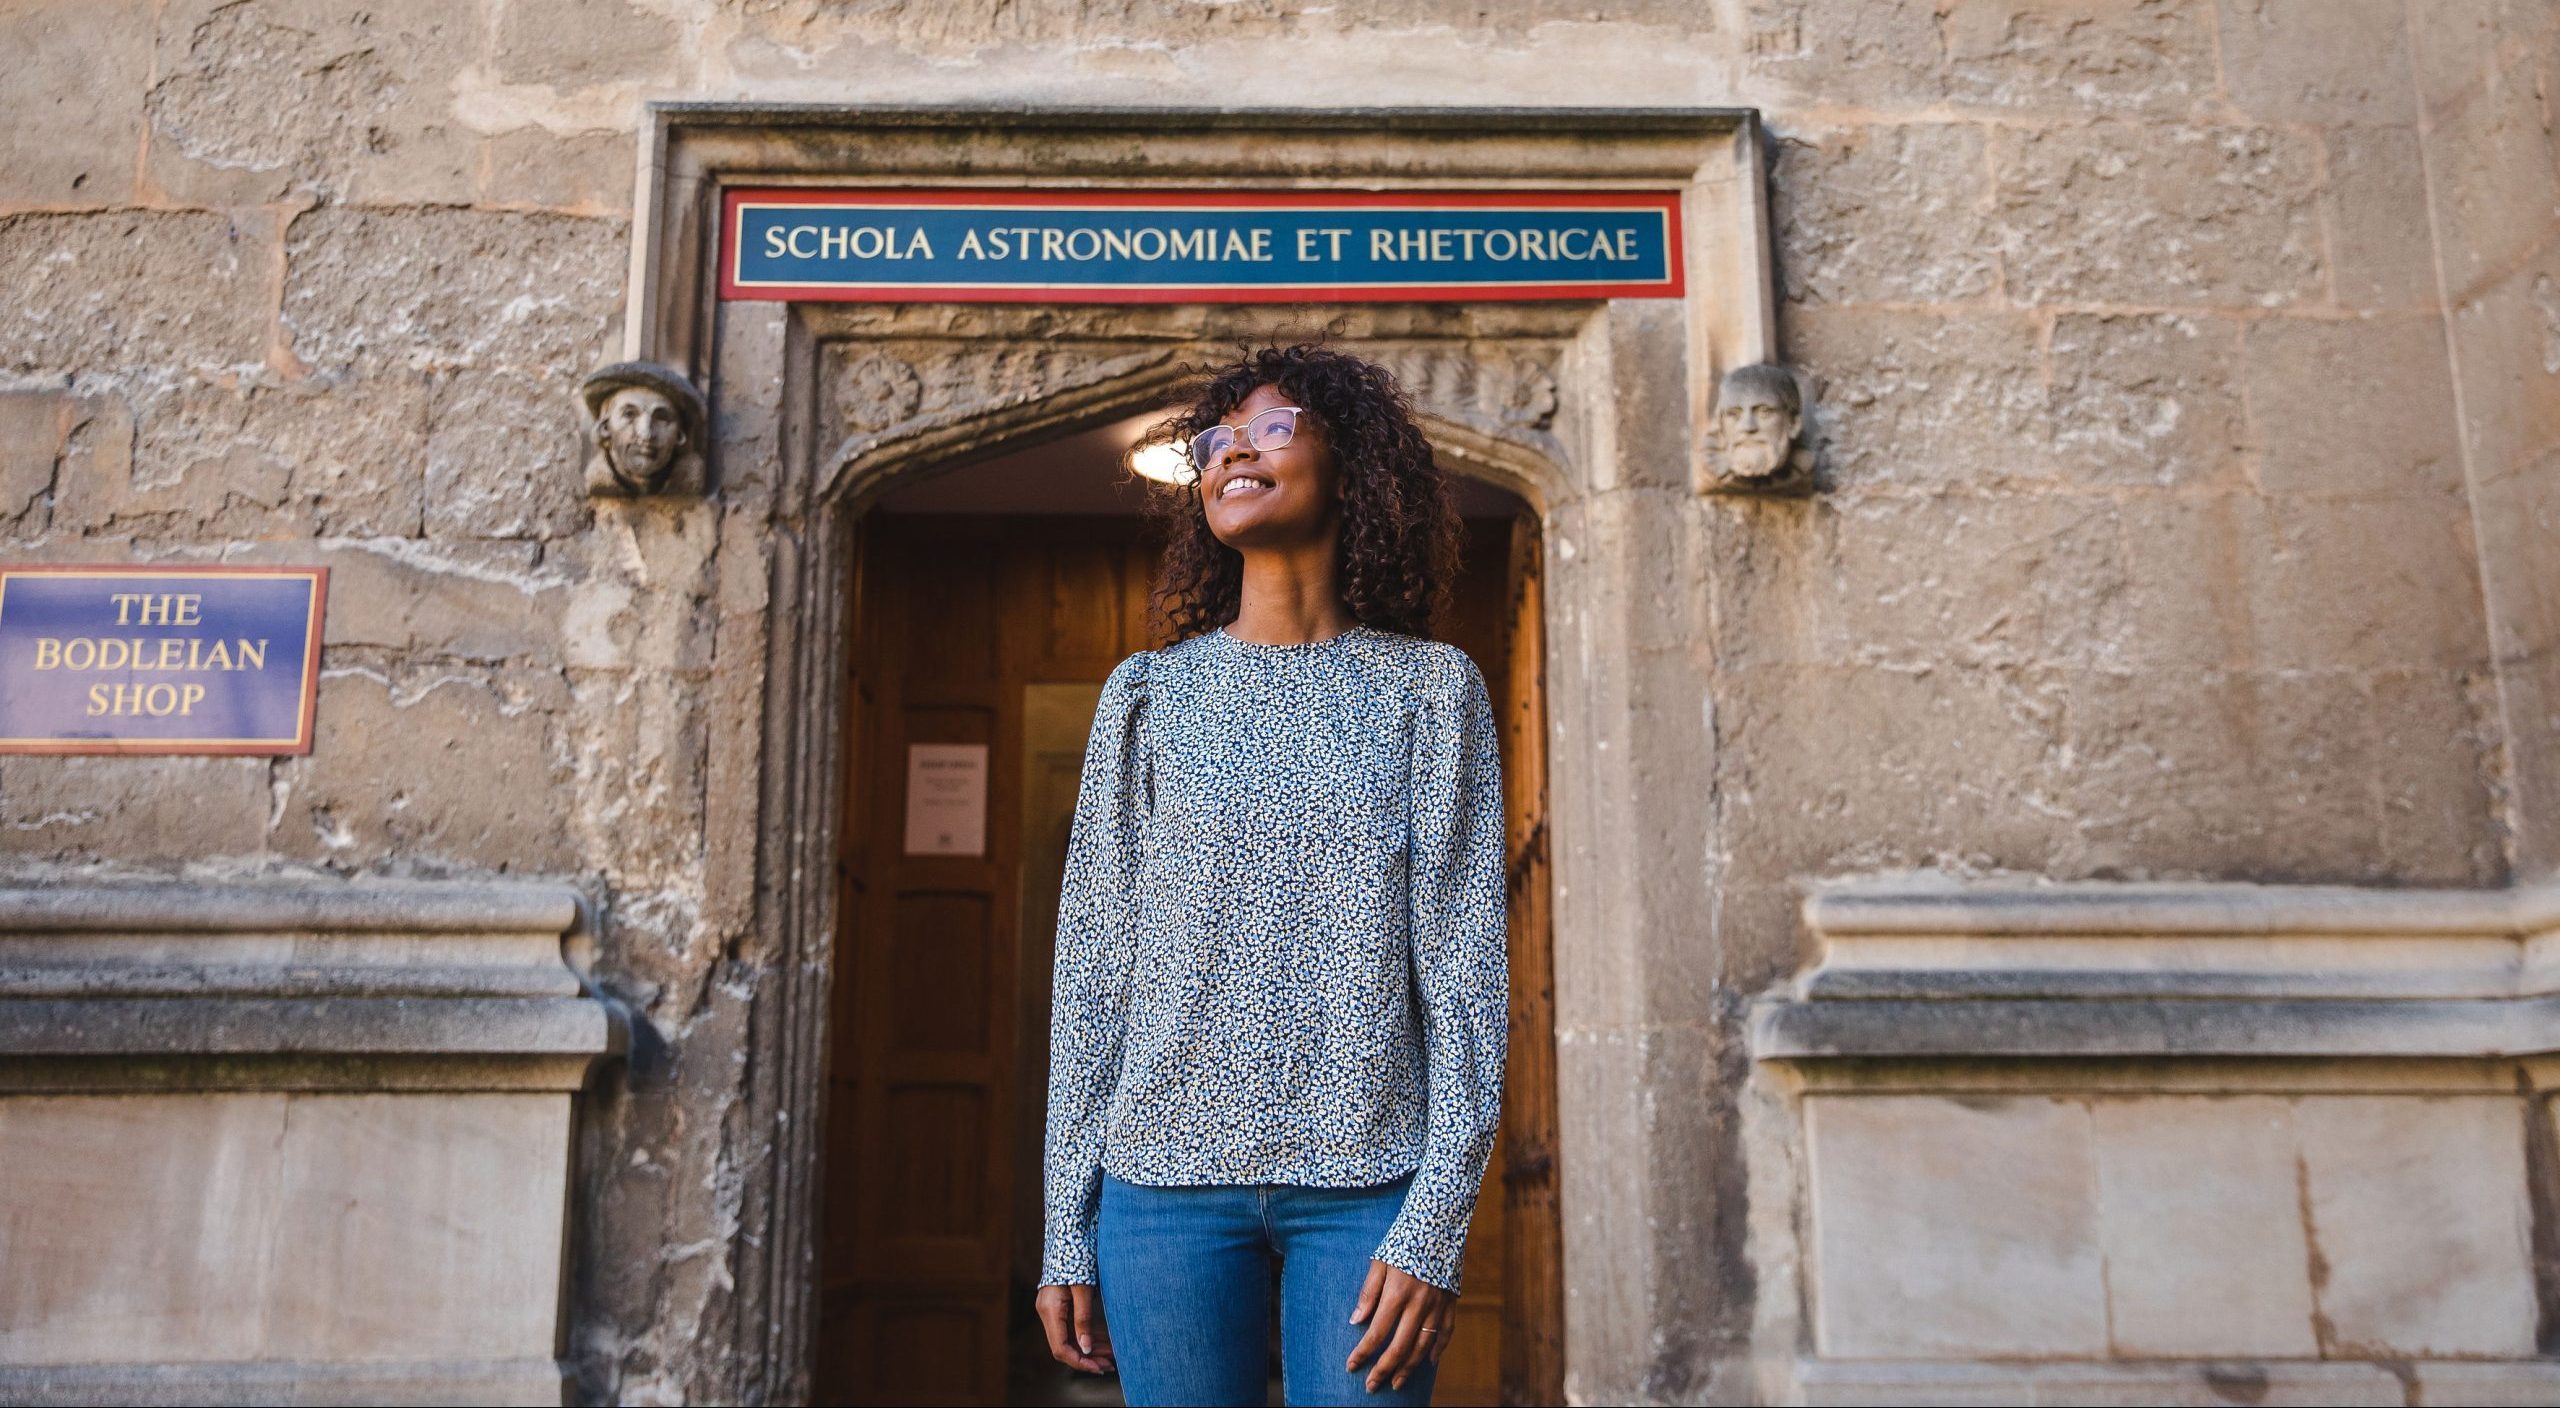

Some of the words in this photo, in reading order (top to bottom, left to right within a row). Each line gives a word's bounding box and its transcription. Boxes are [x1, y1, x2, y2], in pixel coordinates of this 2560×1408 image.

[765, 226, 934, 259] SCHOLA
[957, 228, 1273, 261] ASTRONOMIAE
[1297, 229, 1352, 261] ET
[1370, 228, 1639, 261] RHETORICAE
[110, 593, 203, 626] THE
[34, 637, 269, 671] BODLEIAN
[87, 683, 205, 716] SHOP
